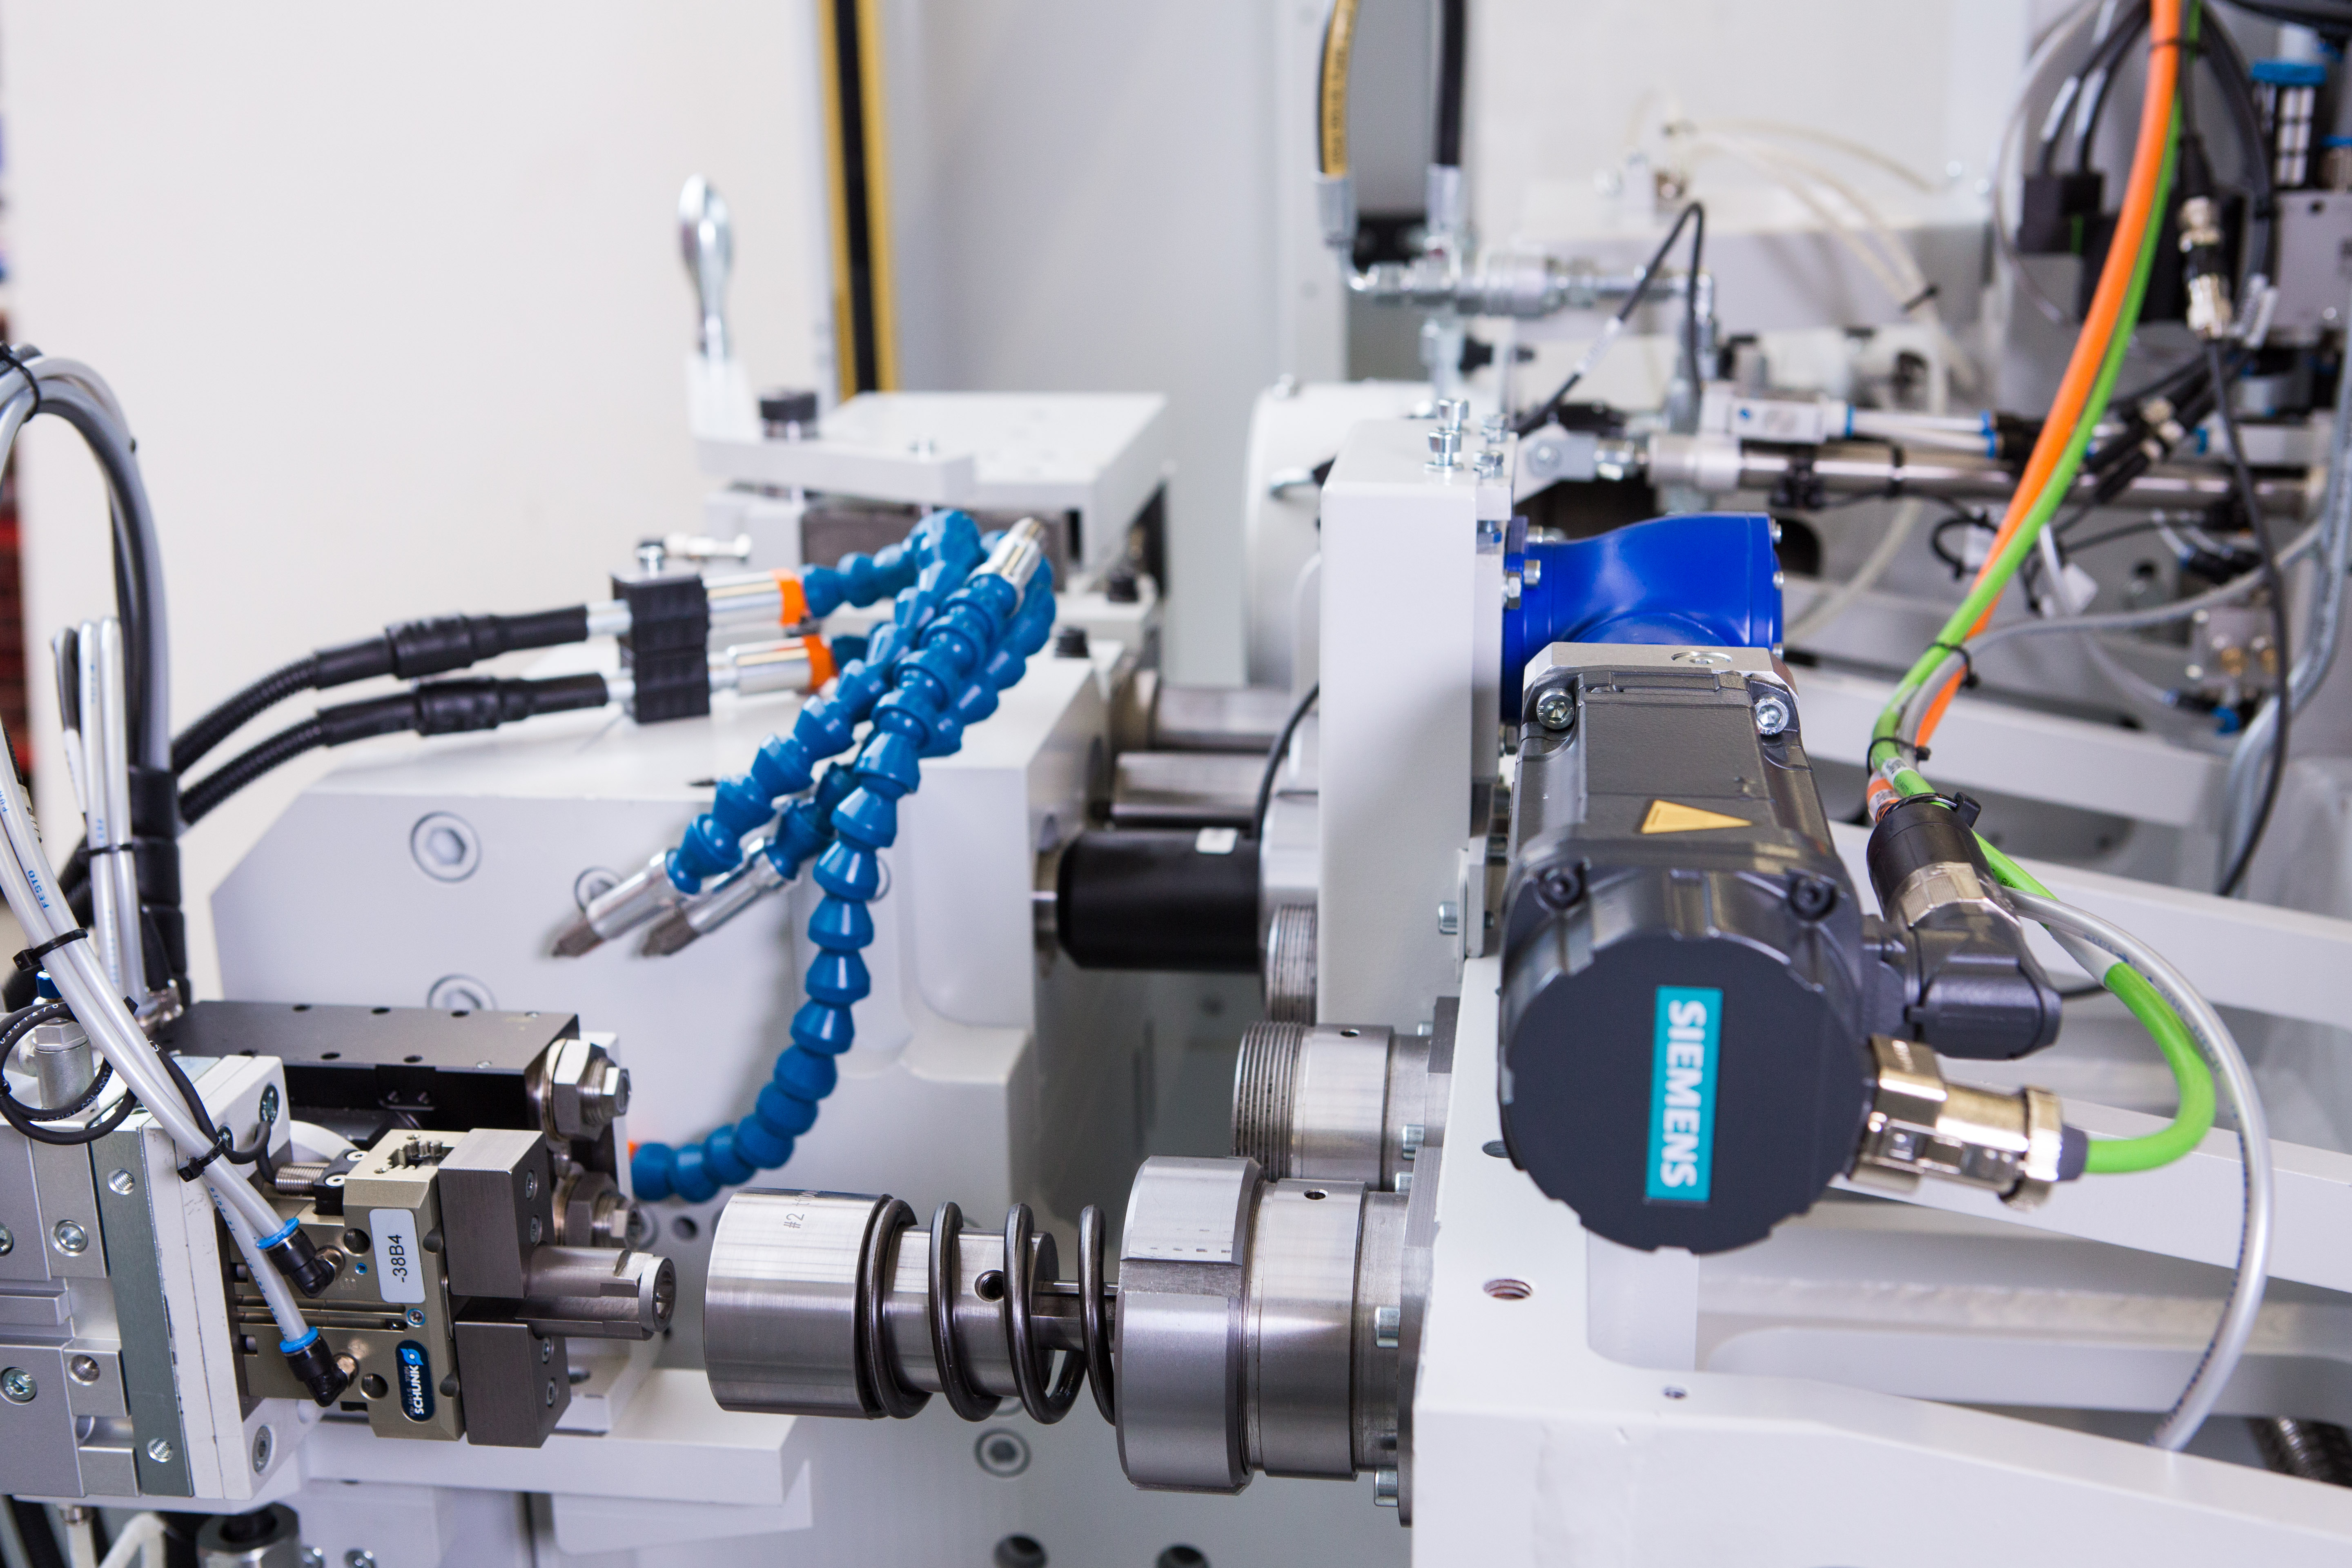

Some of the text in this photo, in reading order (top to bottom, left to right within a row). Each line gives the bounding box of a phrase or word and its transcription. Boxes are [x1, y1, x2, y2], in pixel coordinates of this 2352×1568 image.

[28, 870, 50, 909] FESTO
[1660, 1000, 1707, 1187] SIEMENS
[784, 1213, 804, 1229] #2
[388, 1234, 408, 1283] -38B4
[409, 1365, 424, 1414] SCHUNK
